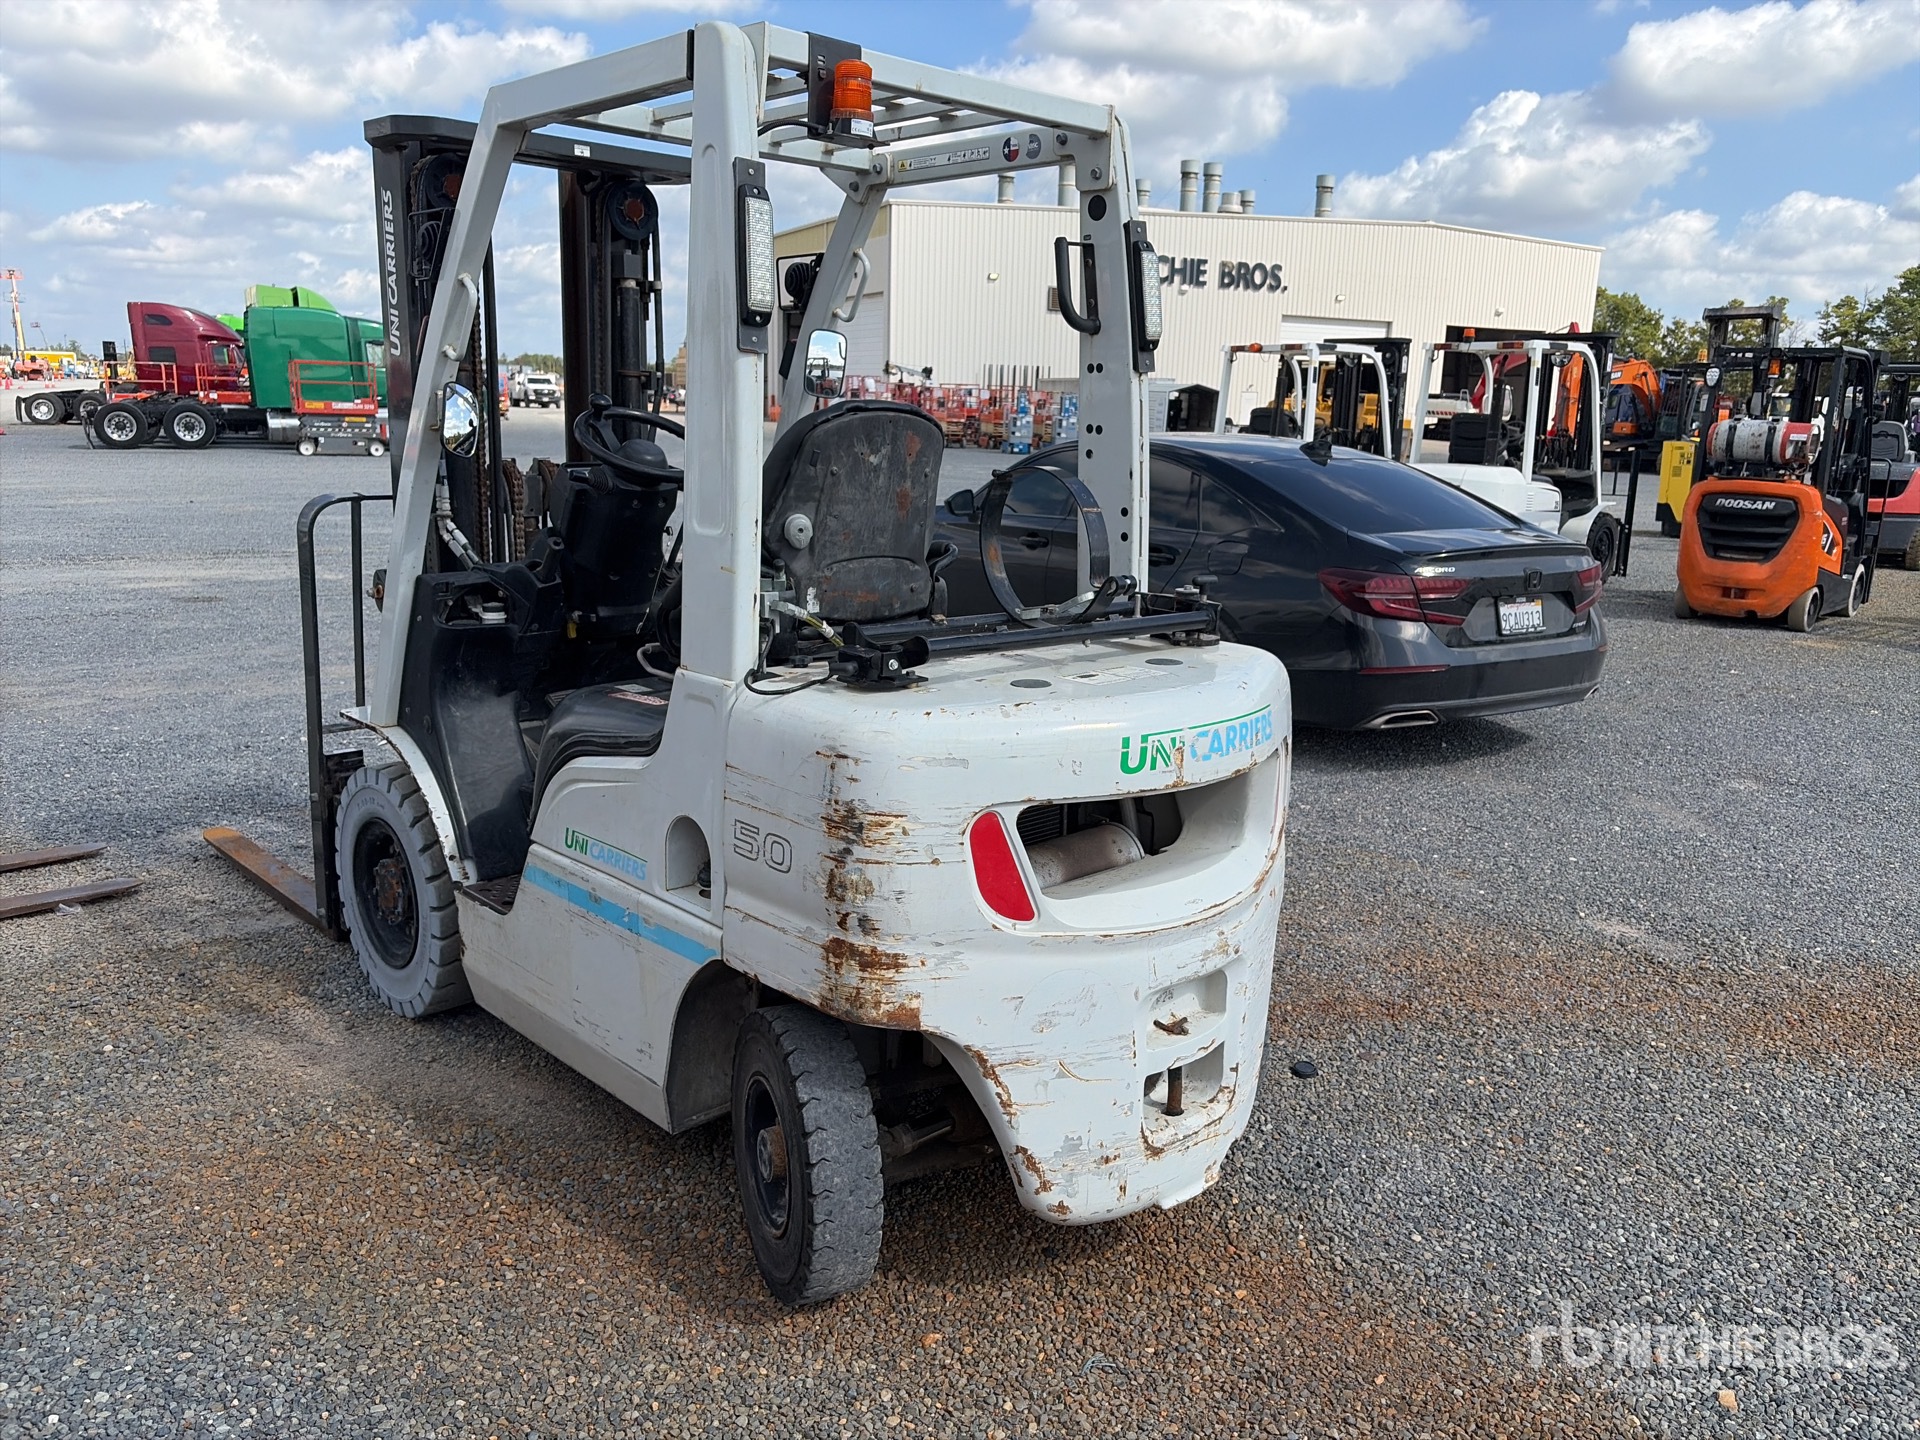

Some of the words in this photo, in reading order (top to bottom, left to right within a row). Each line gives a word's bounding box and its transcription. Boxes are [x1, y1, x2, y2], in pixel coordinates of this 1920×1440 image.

[1219, 260, 1287, 293] BROS.
[1715, 498, 1776, 510] DOOSAN
[1502, 611, 1542, 631] 9CAU313
[564, 827, 588, 855] UNI
[590, 842, 648, 881] CARRIERS
[732, 818, 793, 874] 50
